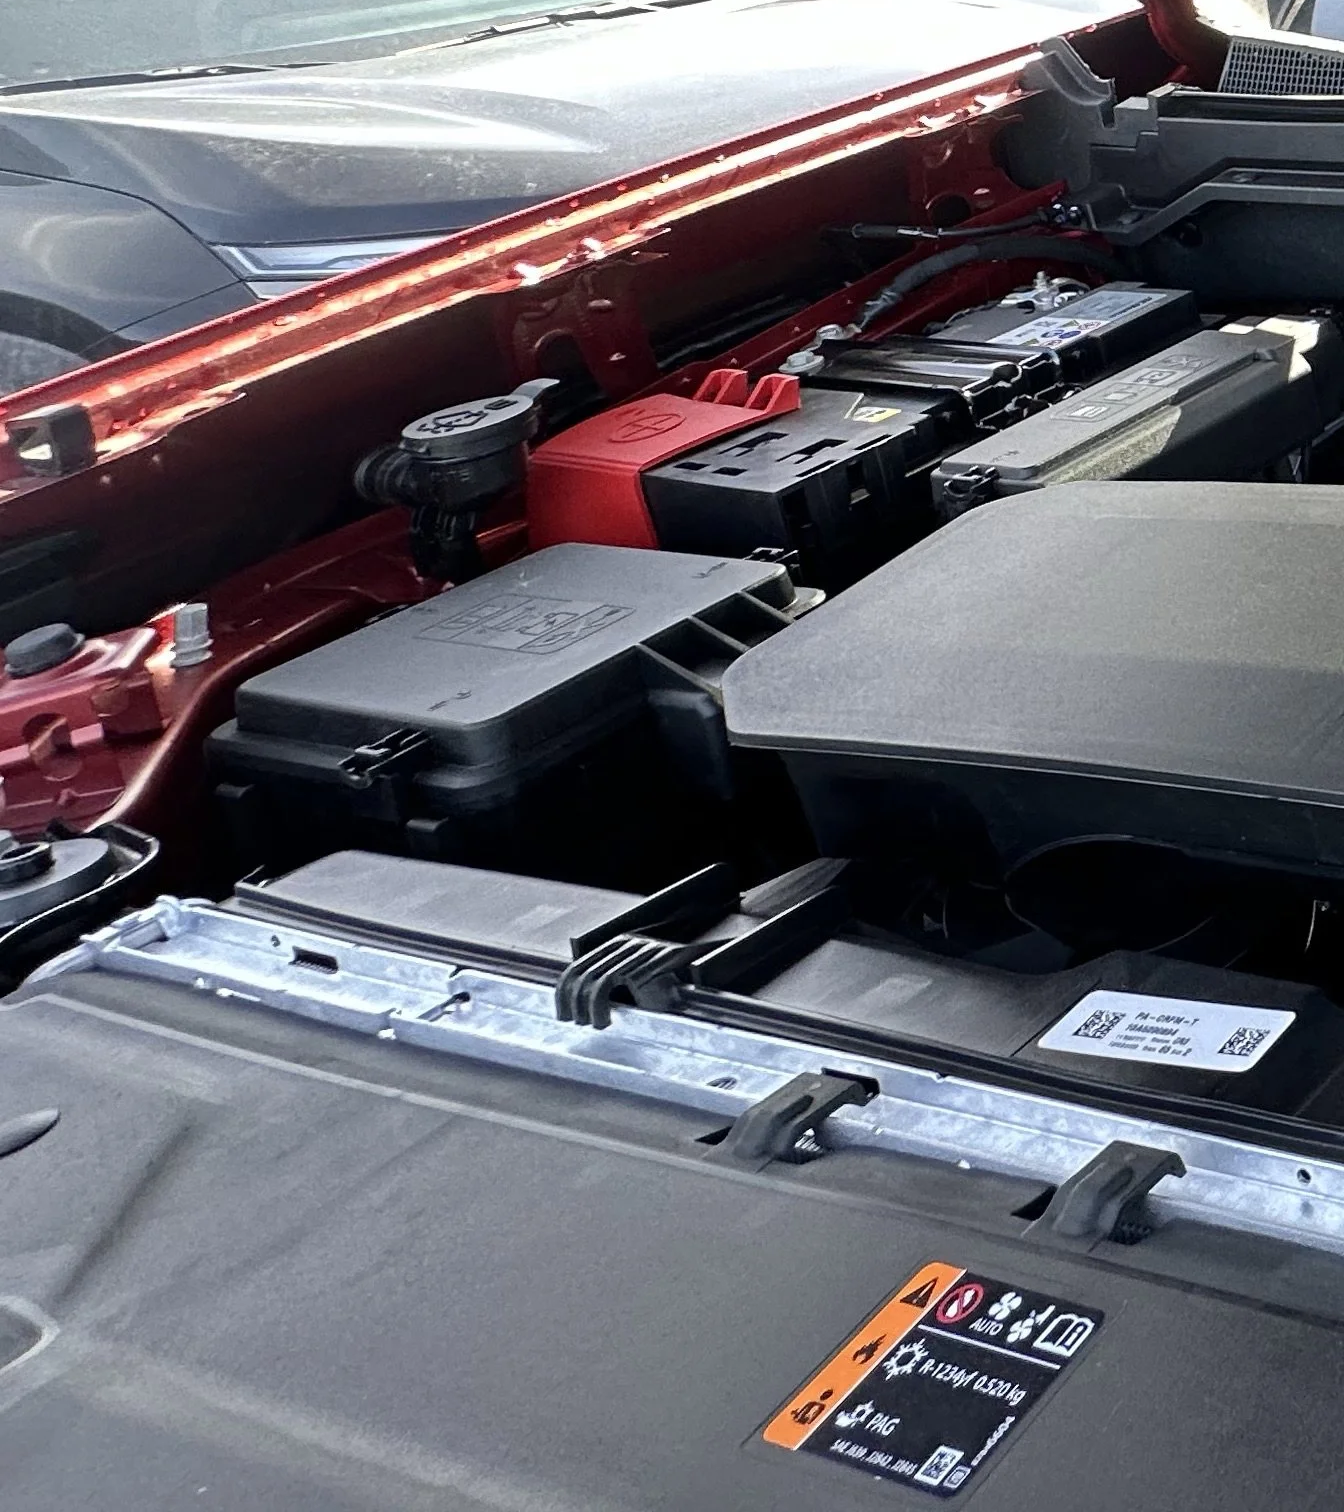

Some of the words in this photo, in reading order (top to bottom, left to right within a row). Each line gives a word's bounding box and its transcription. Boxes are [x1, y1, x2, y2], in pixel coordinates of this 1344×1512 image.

[968, 1318, 1004, 1337] AUTO
[918, 1359, 978, 1388] R-1234yf
[972, 1376, 1010, 1400] 0.520
[1006, 1386, 1027, 1406] kg
[865, 1412, 901, 1437] PAG
